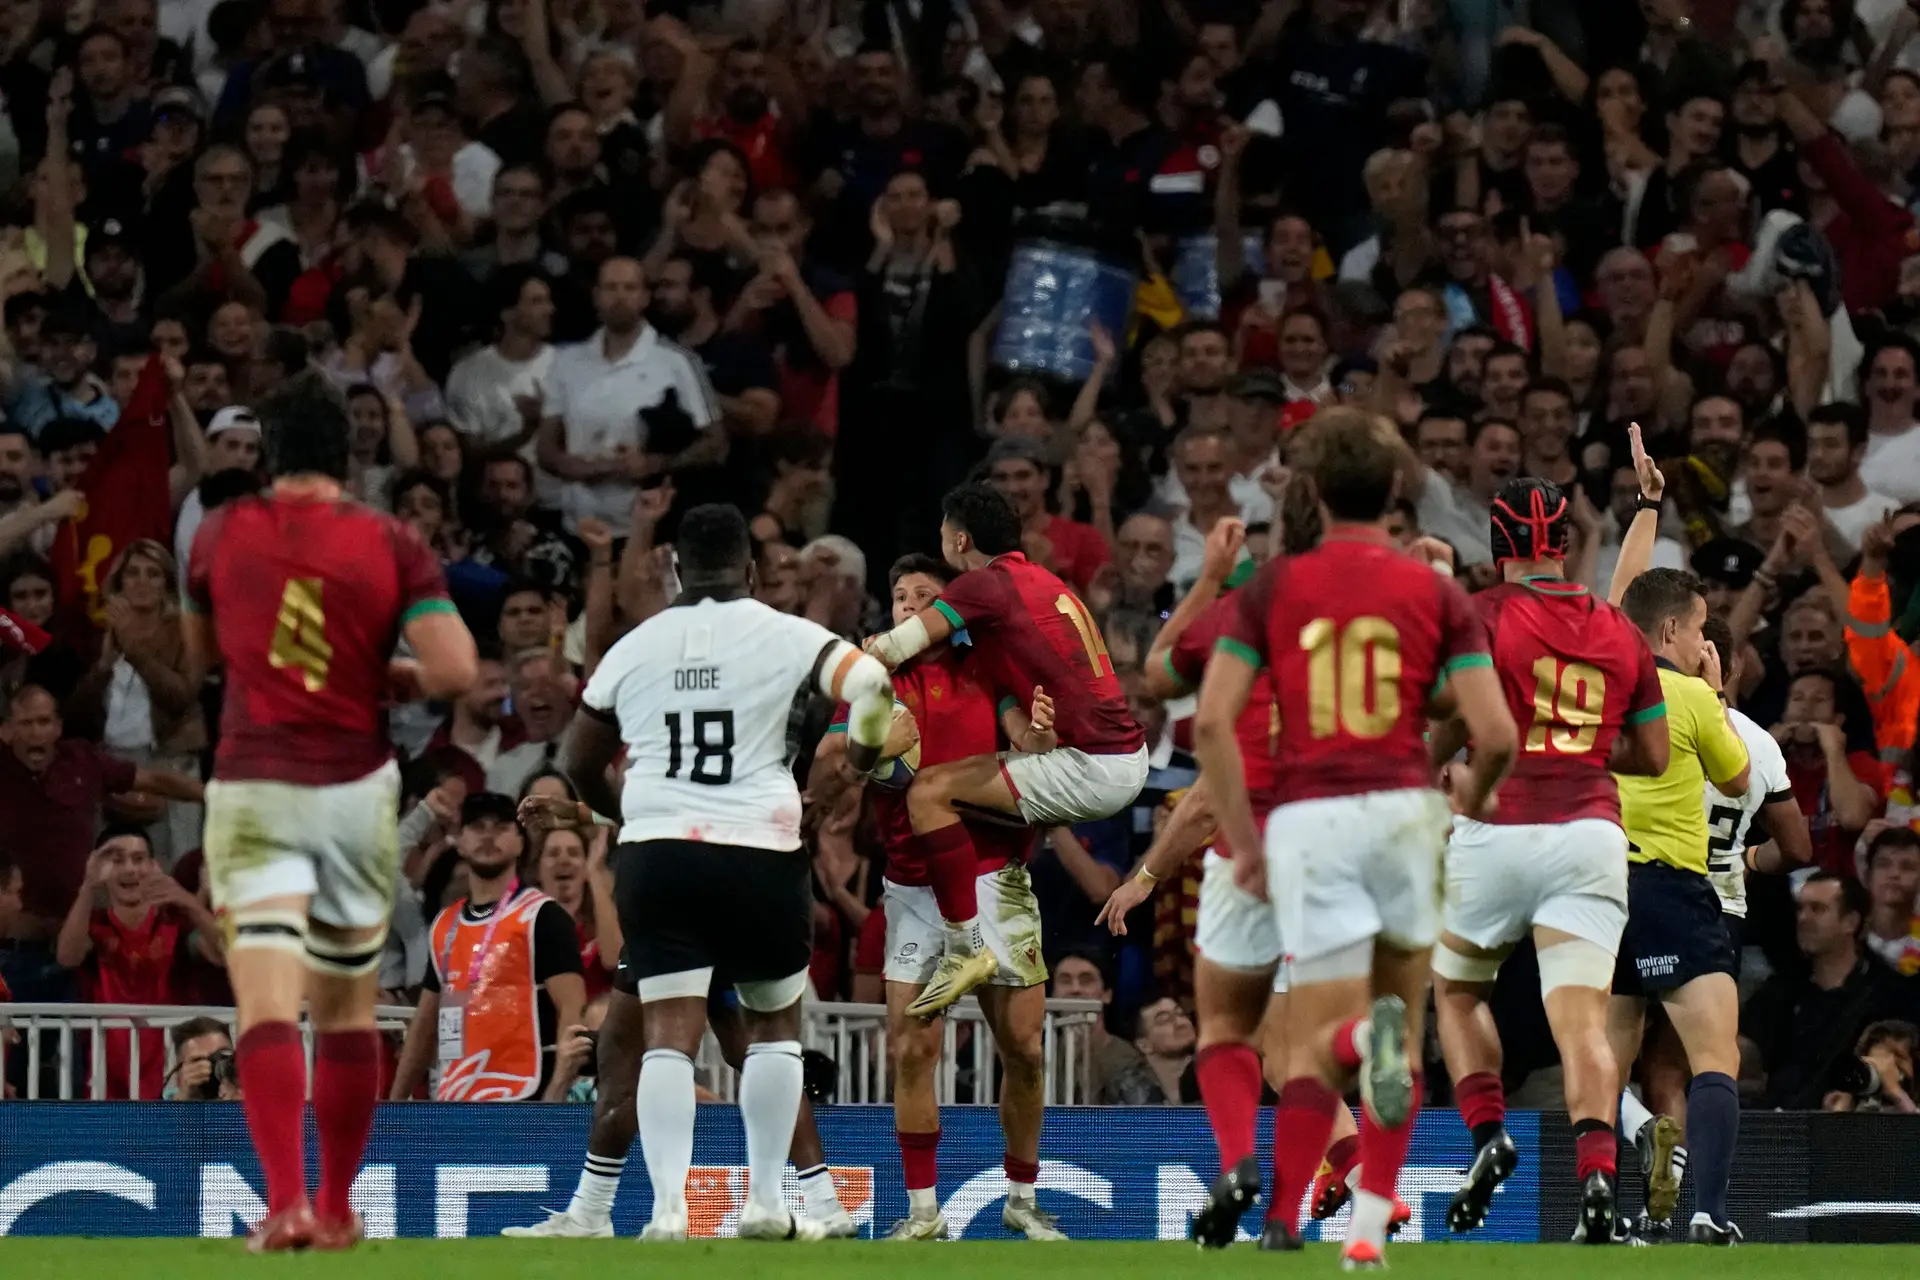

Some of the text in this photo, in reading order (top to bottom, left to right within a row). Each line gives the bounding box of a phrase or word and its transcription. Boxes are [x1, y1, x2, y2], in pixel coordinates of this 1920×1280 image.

[268, 578, 333, 692] 4
[1299, 616, 1402, 740] 10
[674, 668, 721, 691] DOGE
[1525, 655, 1606, 755] 19
[665, 710, 734, 785] 18
[1635, 954, 1680, 970] Emirates
